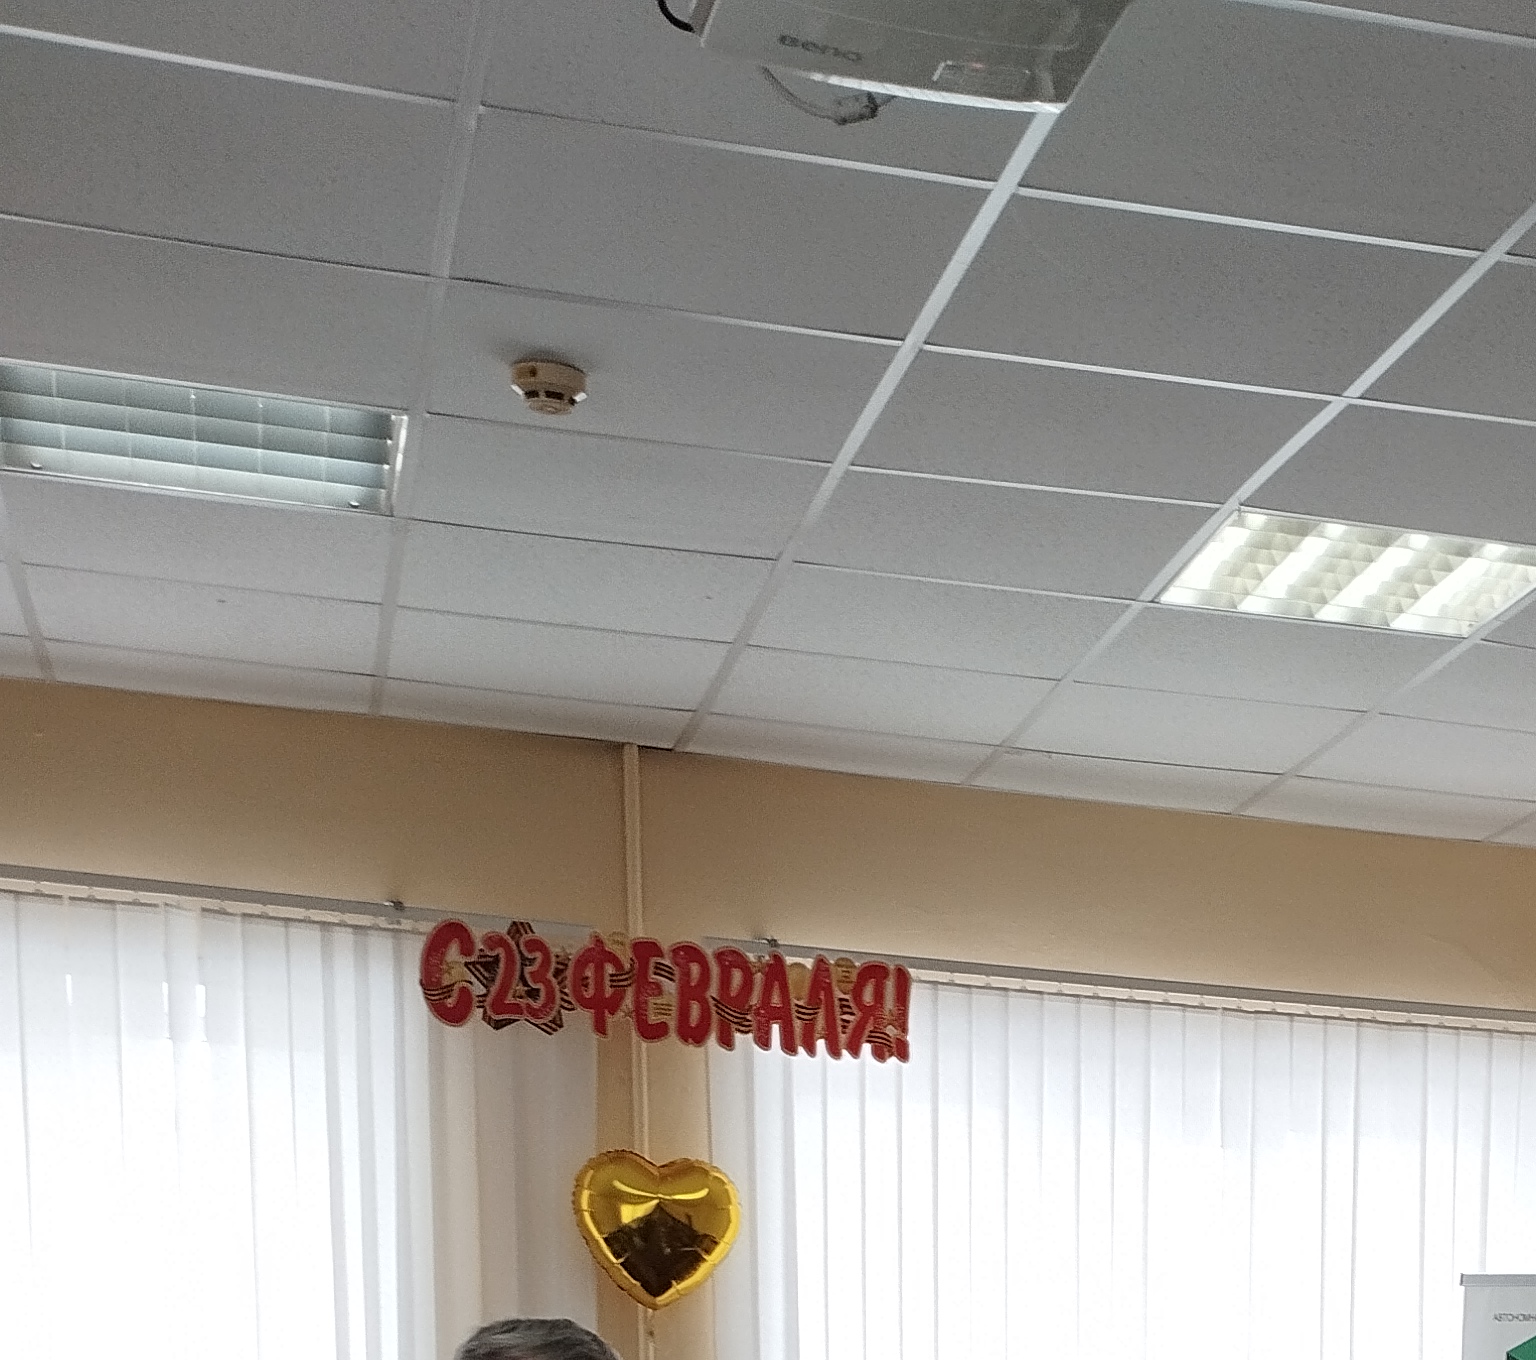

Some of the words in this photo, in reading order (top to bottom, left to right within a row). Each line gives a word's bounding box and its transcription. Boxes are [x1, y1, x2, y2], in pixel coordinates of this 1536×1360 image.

[420, 918, 476, 1027] С
[481, 929, 559, 1024] 23
[570, 930, 912, 1065] ФЕВРАЛЯ!
